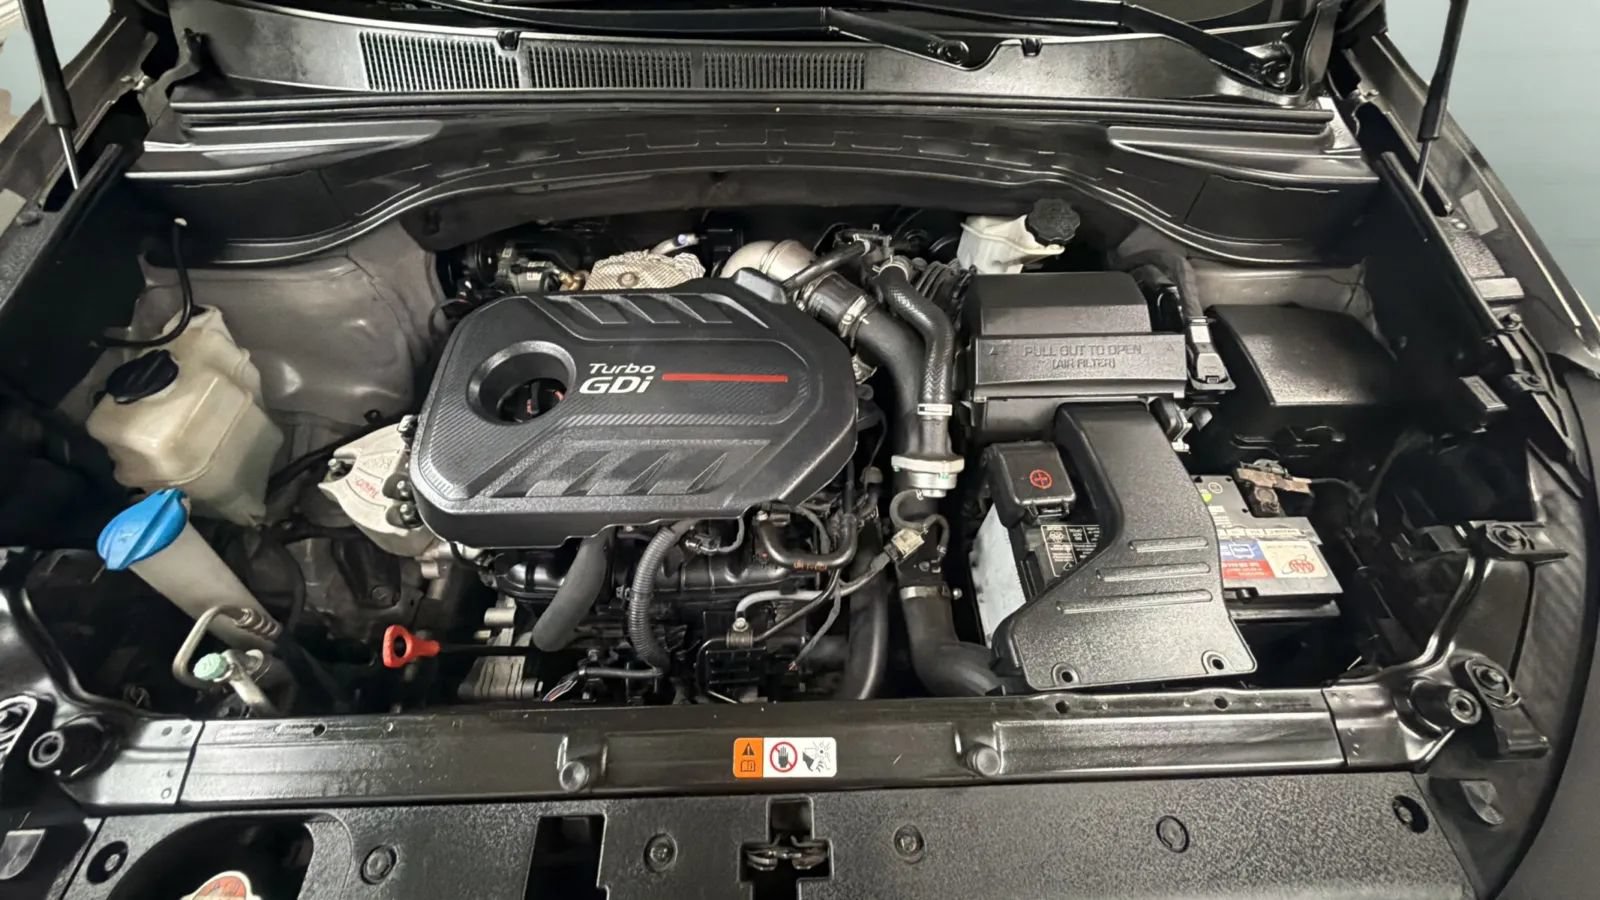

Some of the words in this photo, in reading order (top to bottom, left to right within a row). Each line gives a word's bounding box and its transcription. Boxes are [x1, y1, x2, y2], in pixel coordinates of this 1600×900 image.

[1024, 344, 1056, 357] PULL
[1060, 344, 1085, 357] OUT
[1088, 344, 1105, 356] TO
[1108, 344, 1142, 356] OPEN
[589, 363, 656, 374] Turbo
[579, 376, 655, 394] GDi
